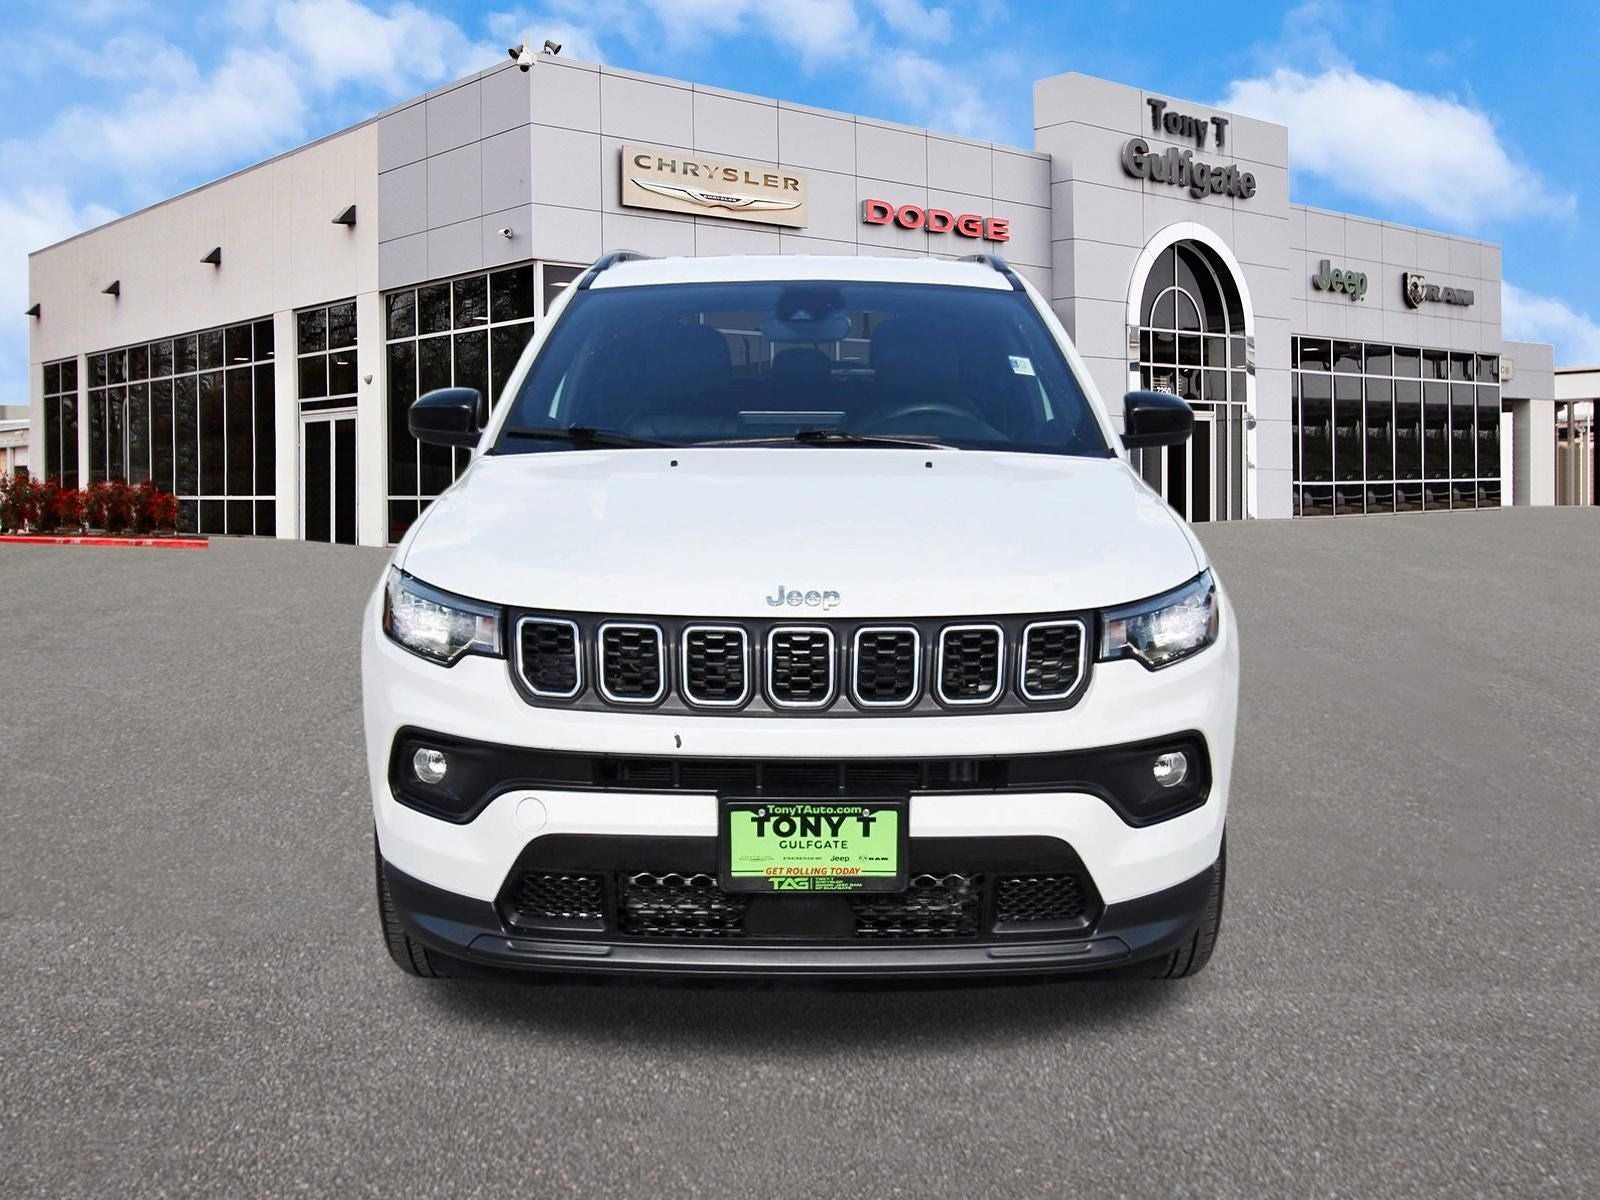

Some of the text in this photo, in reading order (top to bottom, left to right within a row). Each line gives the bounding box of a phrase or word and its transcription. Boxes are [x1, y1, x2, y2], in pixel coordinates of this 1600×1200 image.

[1146, 98, 1229, 147] Tony T
[633, 154, 800, 192] CHRYSLER
[1121, 138, 1256, 199] Gulfgate
[862, 198, 1011, 242] DODGE
[1313, 259, 1368, 301] Jeep
[1424, 284, 1474, 306] RAM
[765, 585, 841, 611] Jeep
[766, 804, 862, 816] TonyTAuto.com
[751, 815, 877, 838] TONY T
[779, 840, 848, 849] GULFGATE
[830, 855, 850, 863] Jeep
[765, 867, 861, 875] GET ROLLING TODAY
[768, 877, 809, 890] TAG
